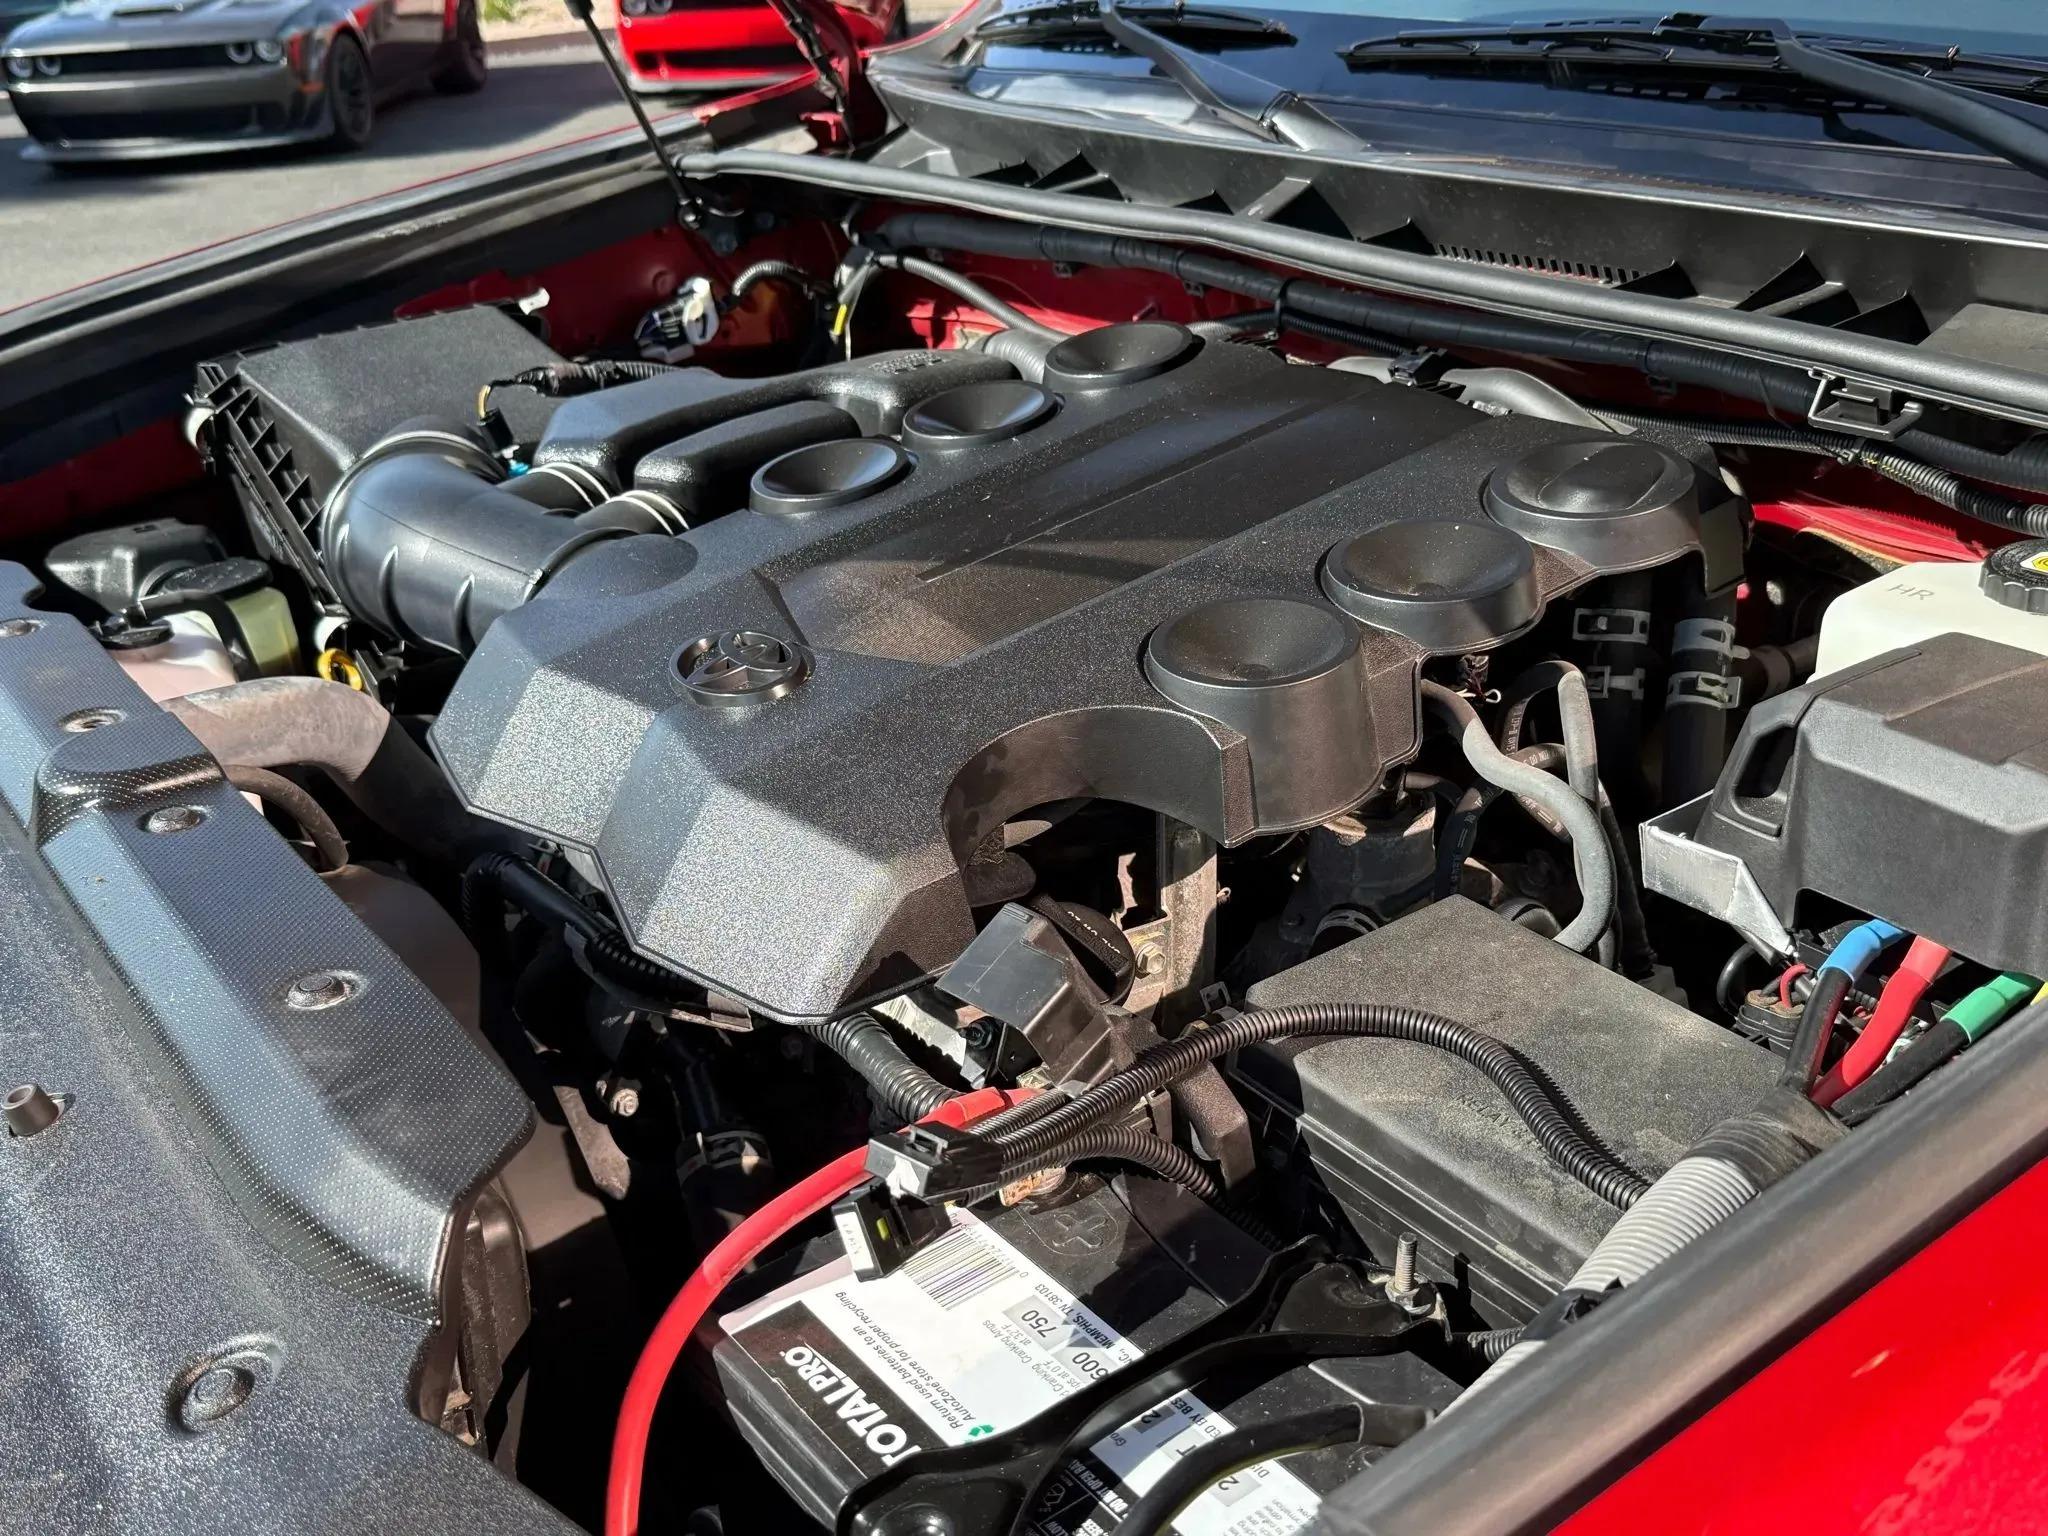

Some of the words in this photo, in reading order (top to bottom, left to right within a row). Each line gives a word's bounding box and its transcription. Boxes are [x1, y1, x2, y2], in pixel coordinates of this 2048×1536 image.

[1033, 1282, 1063, 1305] 38103
[835, 1291, 872, 1323] recycling
[1057, 1303, 1072, 1316] TN
[851, 1324, 867, 1335] an
[981, 1318, 1004, 1338] Amps
[1020, 1308, 1057, 1338] 750
[1072, 1312, 1115, 1349] MEMPHIS,
[864, 1335, 876, 1345] to
[868, 1325, 900, 1346] proper
[1018, 1336, 1032, 1346] at
[893, 1348, 911, 1360] for
[999, 1335, 1032, 1363] Cranking
[872, 1344, 911, 1378] batteries
[908, 1359, 933, 1381] store
[1071, 1350, 1108, 1379] 600
[1031, 1363, 1066, 1392] Cranking
[1056, 1369, 1070, 1379] at
[904, 1377, 933, 1399] used
[930, 1398, 963, 1429] Return
[1169, 1394, 1194, 1415] BES
[1187, 1412, 1208, 1426] BY
[1078, 1469, 1104, 1490] OPEN
[1094, 1485, 1118, 1504] NOT
